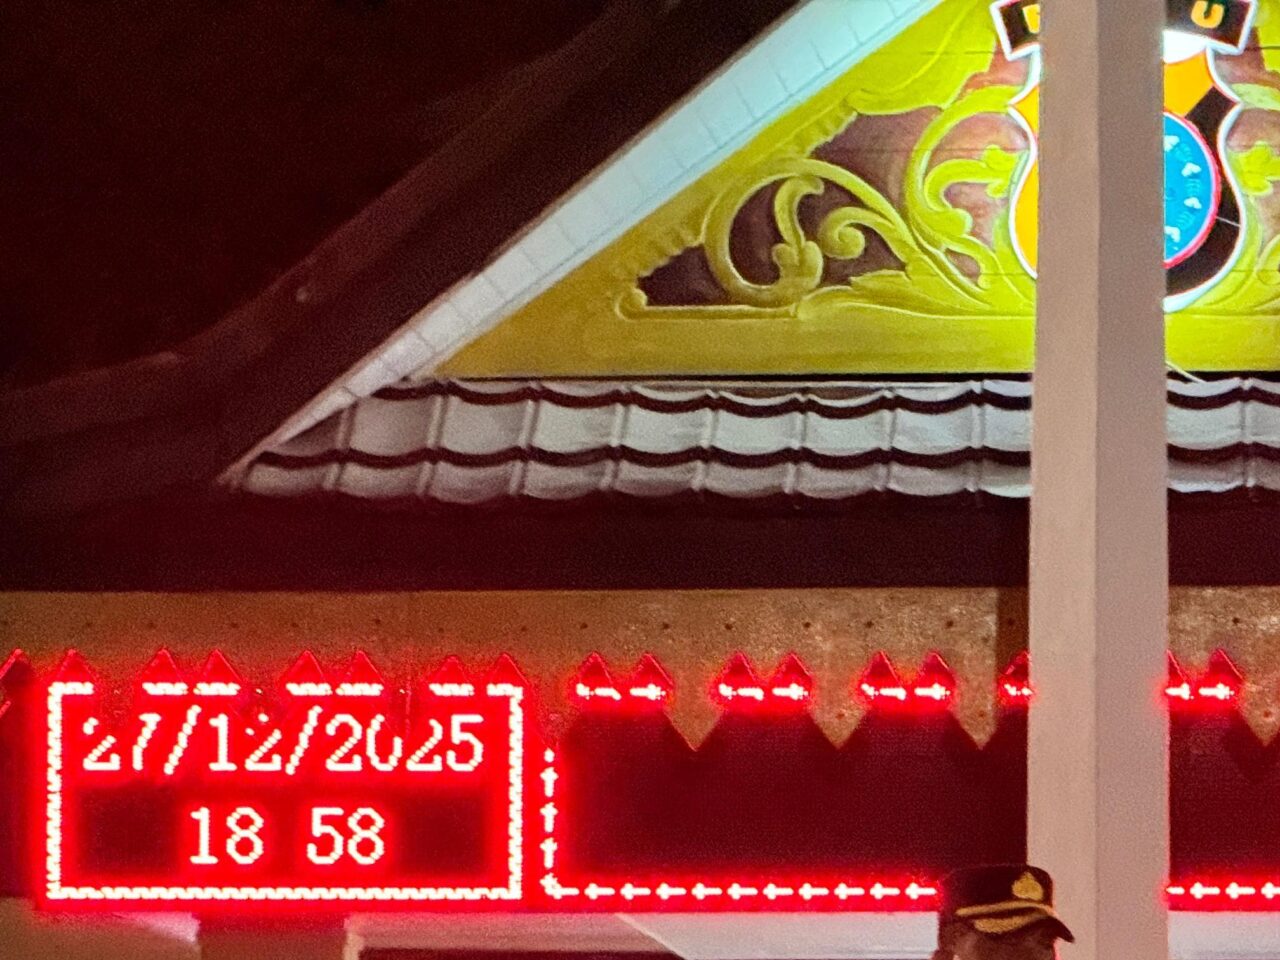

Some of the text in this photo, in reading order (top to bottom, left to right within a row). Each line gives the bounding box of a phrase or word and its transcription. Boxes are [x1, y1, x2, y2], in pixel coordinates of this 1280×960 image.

[83, 704, 484, 775] 27/12/2025
[190, 807, 385, 865] 18 58
